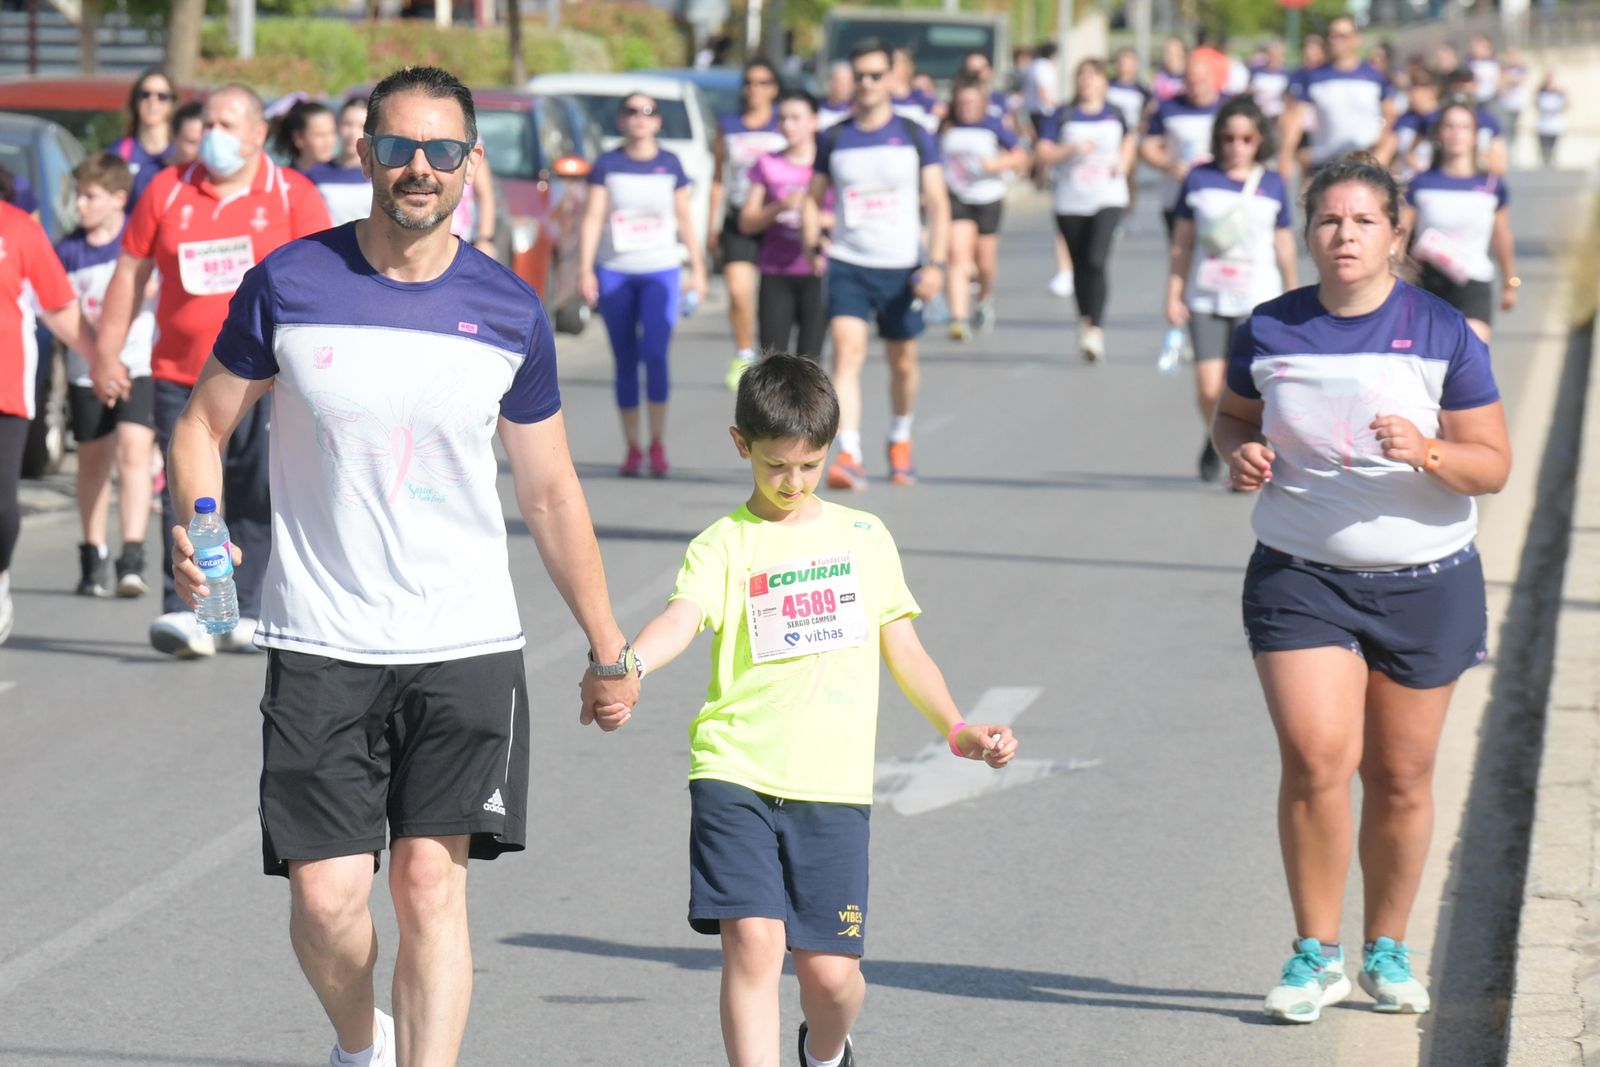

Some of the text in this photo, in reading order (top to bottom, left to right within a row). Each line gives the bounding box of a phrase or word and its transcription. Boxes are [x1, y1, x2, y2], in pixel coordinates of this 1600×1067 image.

[768, 561, 851, 588] COVIRAN
[782, 588, 836, 619] 4589
[787, 614, 836, 629] SERGIO CAMPEON
[805, 628, 843, 643] vithas
[838, 910, 863, 923] VIBES
